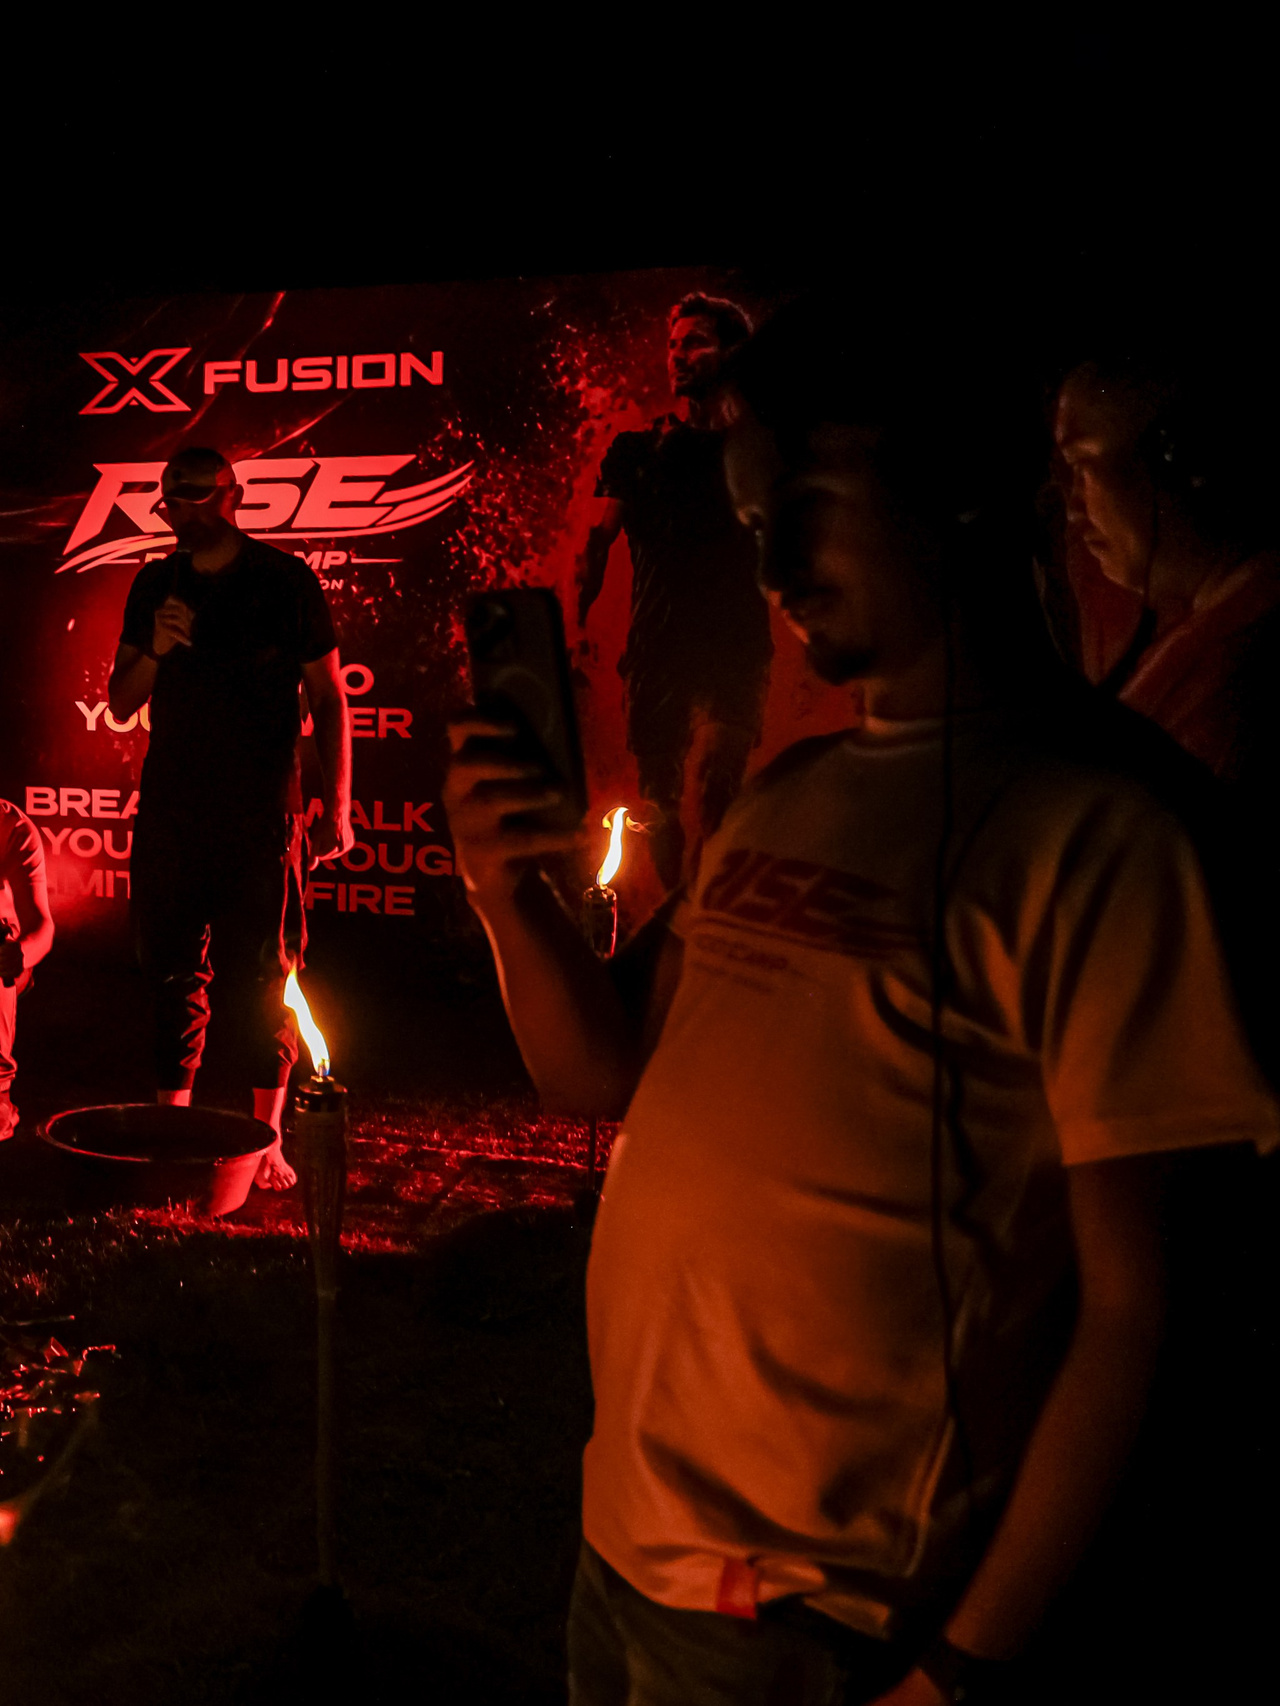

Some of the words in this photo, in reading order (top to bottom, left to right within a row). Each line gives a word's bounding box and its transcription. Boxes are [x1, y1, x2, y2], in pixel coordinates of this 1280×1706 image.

[204, 351, 444, 394] FUSION
[63, 454, 417, 556] RSE
[306, 881, 416, 916] FIRE
